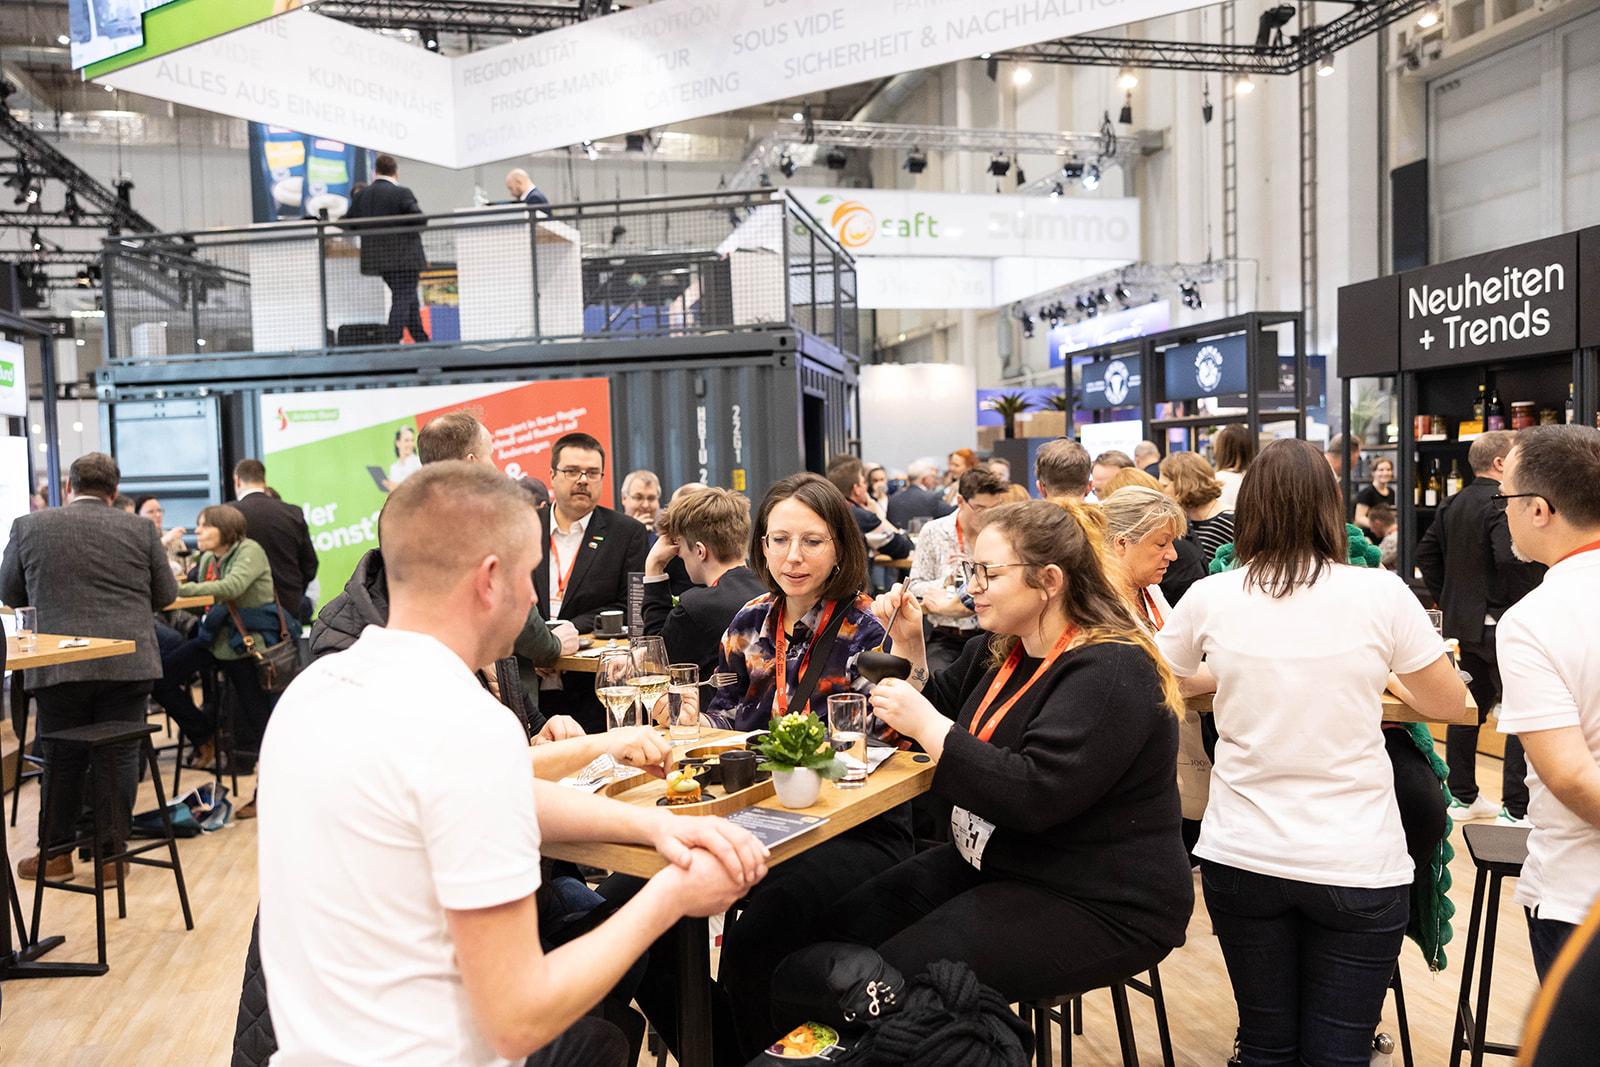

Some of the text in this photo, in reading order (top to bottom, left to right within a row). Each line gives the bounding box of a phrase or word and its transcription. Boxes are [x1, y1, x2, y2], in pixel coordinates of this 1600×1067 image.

[617, 1, 721, 42] TRADITION
[731, 8, 846, 56] SOUS VIDE
[462, 38, 580, 88] REGIONALITÄT
[783, 29, 914, 80] SICHERHEIT
[919, 24, 937, 49] &
[155, 60, 409, 142] ALLES AUS EINER HAND
[307, 64, 446, 120] KUNDENNÄHE
[643, 71, 740, 112] CATERING
[988, 211, 1130, 243] zummo
[1408, 262, 1565, 320] Neuheiten
[1419, 300, 1551, 351] + Trends
